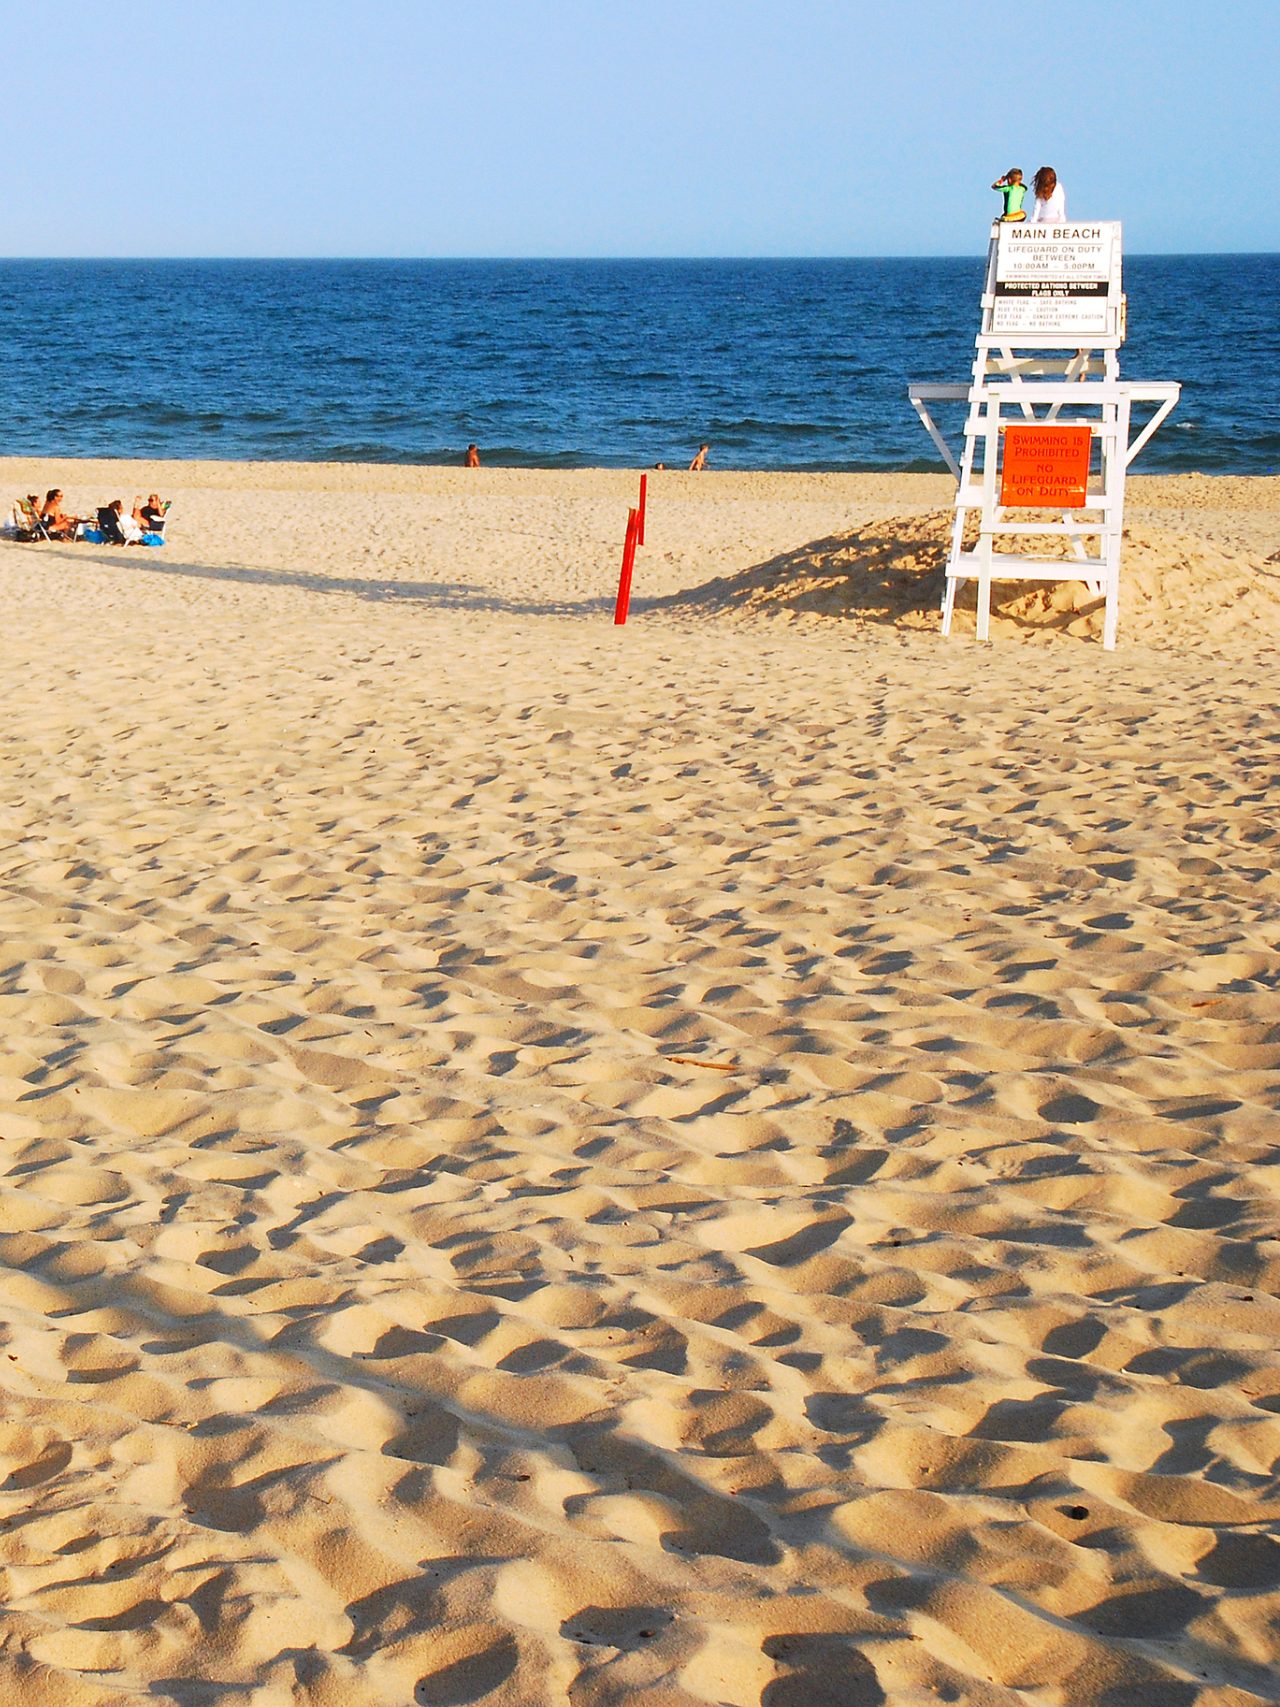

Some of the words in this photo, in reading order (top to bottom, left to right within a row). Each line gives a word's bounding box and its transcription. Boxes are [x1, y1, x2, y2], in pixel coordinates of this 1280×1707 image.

[1012, 229, 1047, 239] MAIN
[1053, 229, 1101, 239] BEACH
[1012, 435, 1068, 445] SWIMMING
[1073, 436, 1083, 445] IS
[1015, 447, 1080, 457] PROHIBITED
[1036, 464, 1053, 473] NO
[1012, 475, 1077, 485] LIFEGUARD
[1016, 487, 1033, 496] ON
[1039, 487, 1071, 496] DUTY
